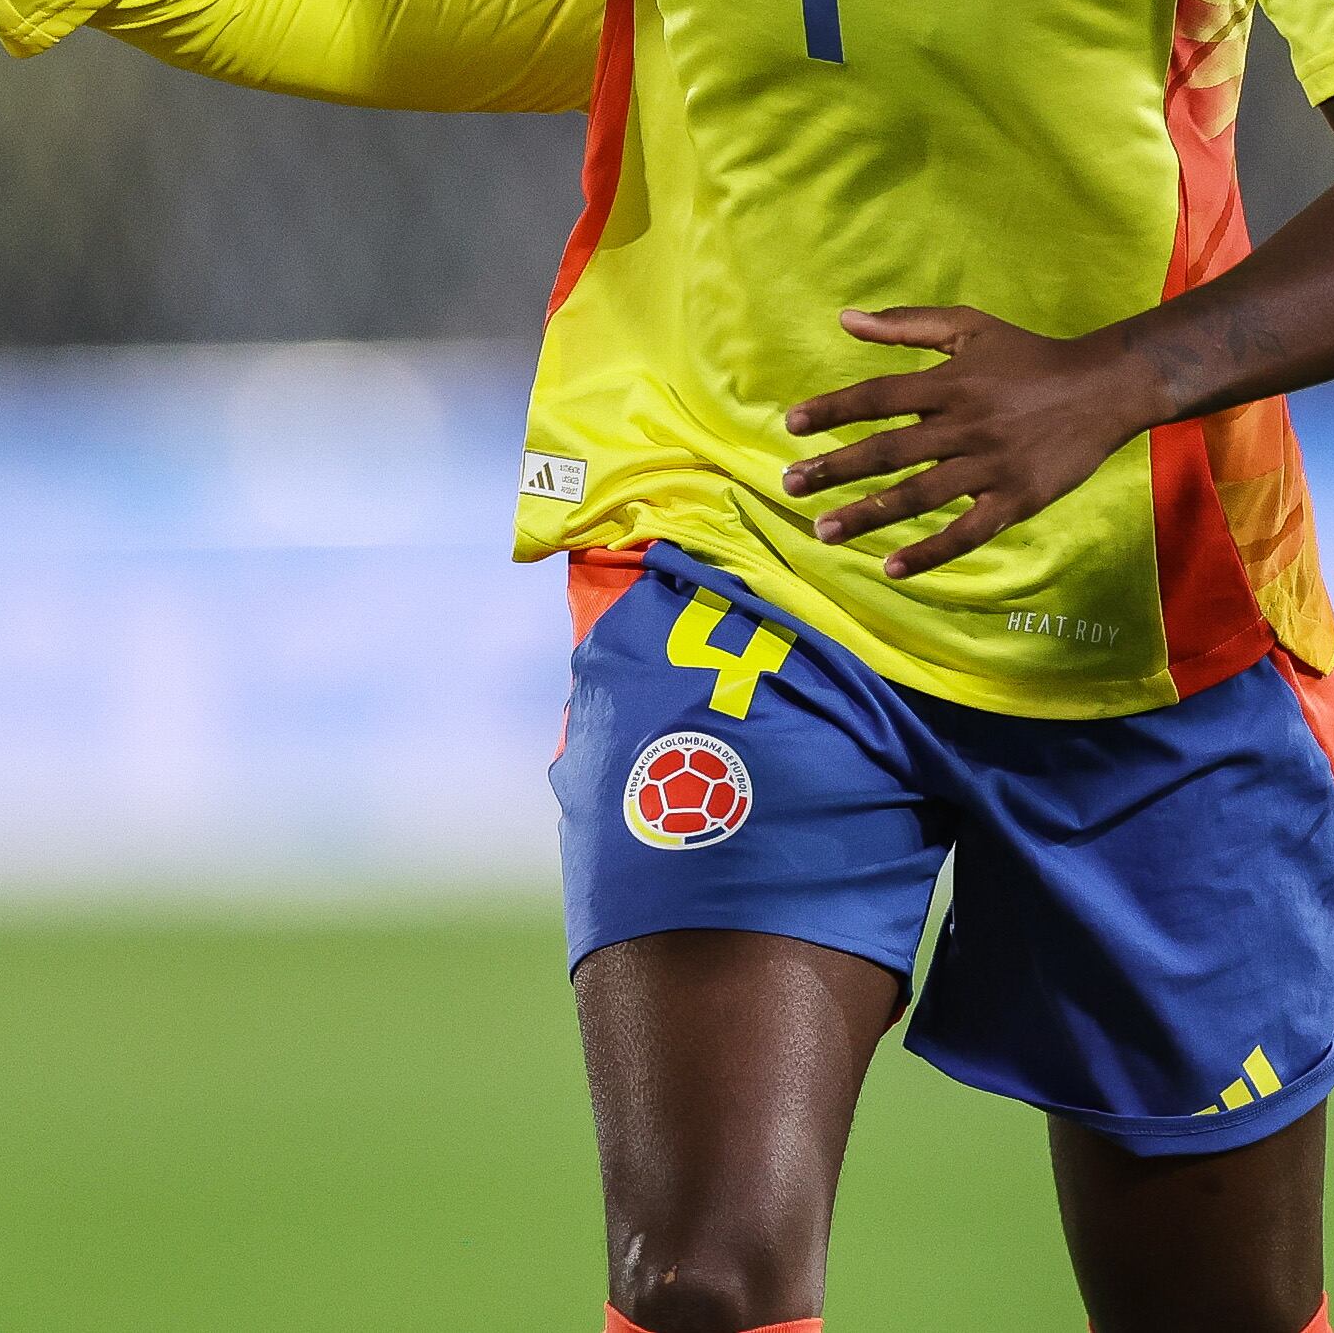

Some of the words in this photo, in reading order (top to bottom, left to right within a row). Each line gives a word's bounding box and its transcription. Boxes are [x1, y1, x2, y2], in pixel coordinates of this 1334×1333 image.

[1007, 611, 1120, 647] HEAT.RDY
[666, 585, 798, 721] 4
[660, 736, 723, 755] COLOMBIANA
[721, 750, 735, 763] DE
